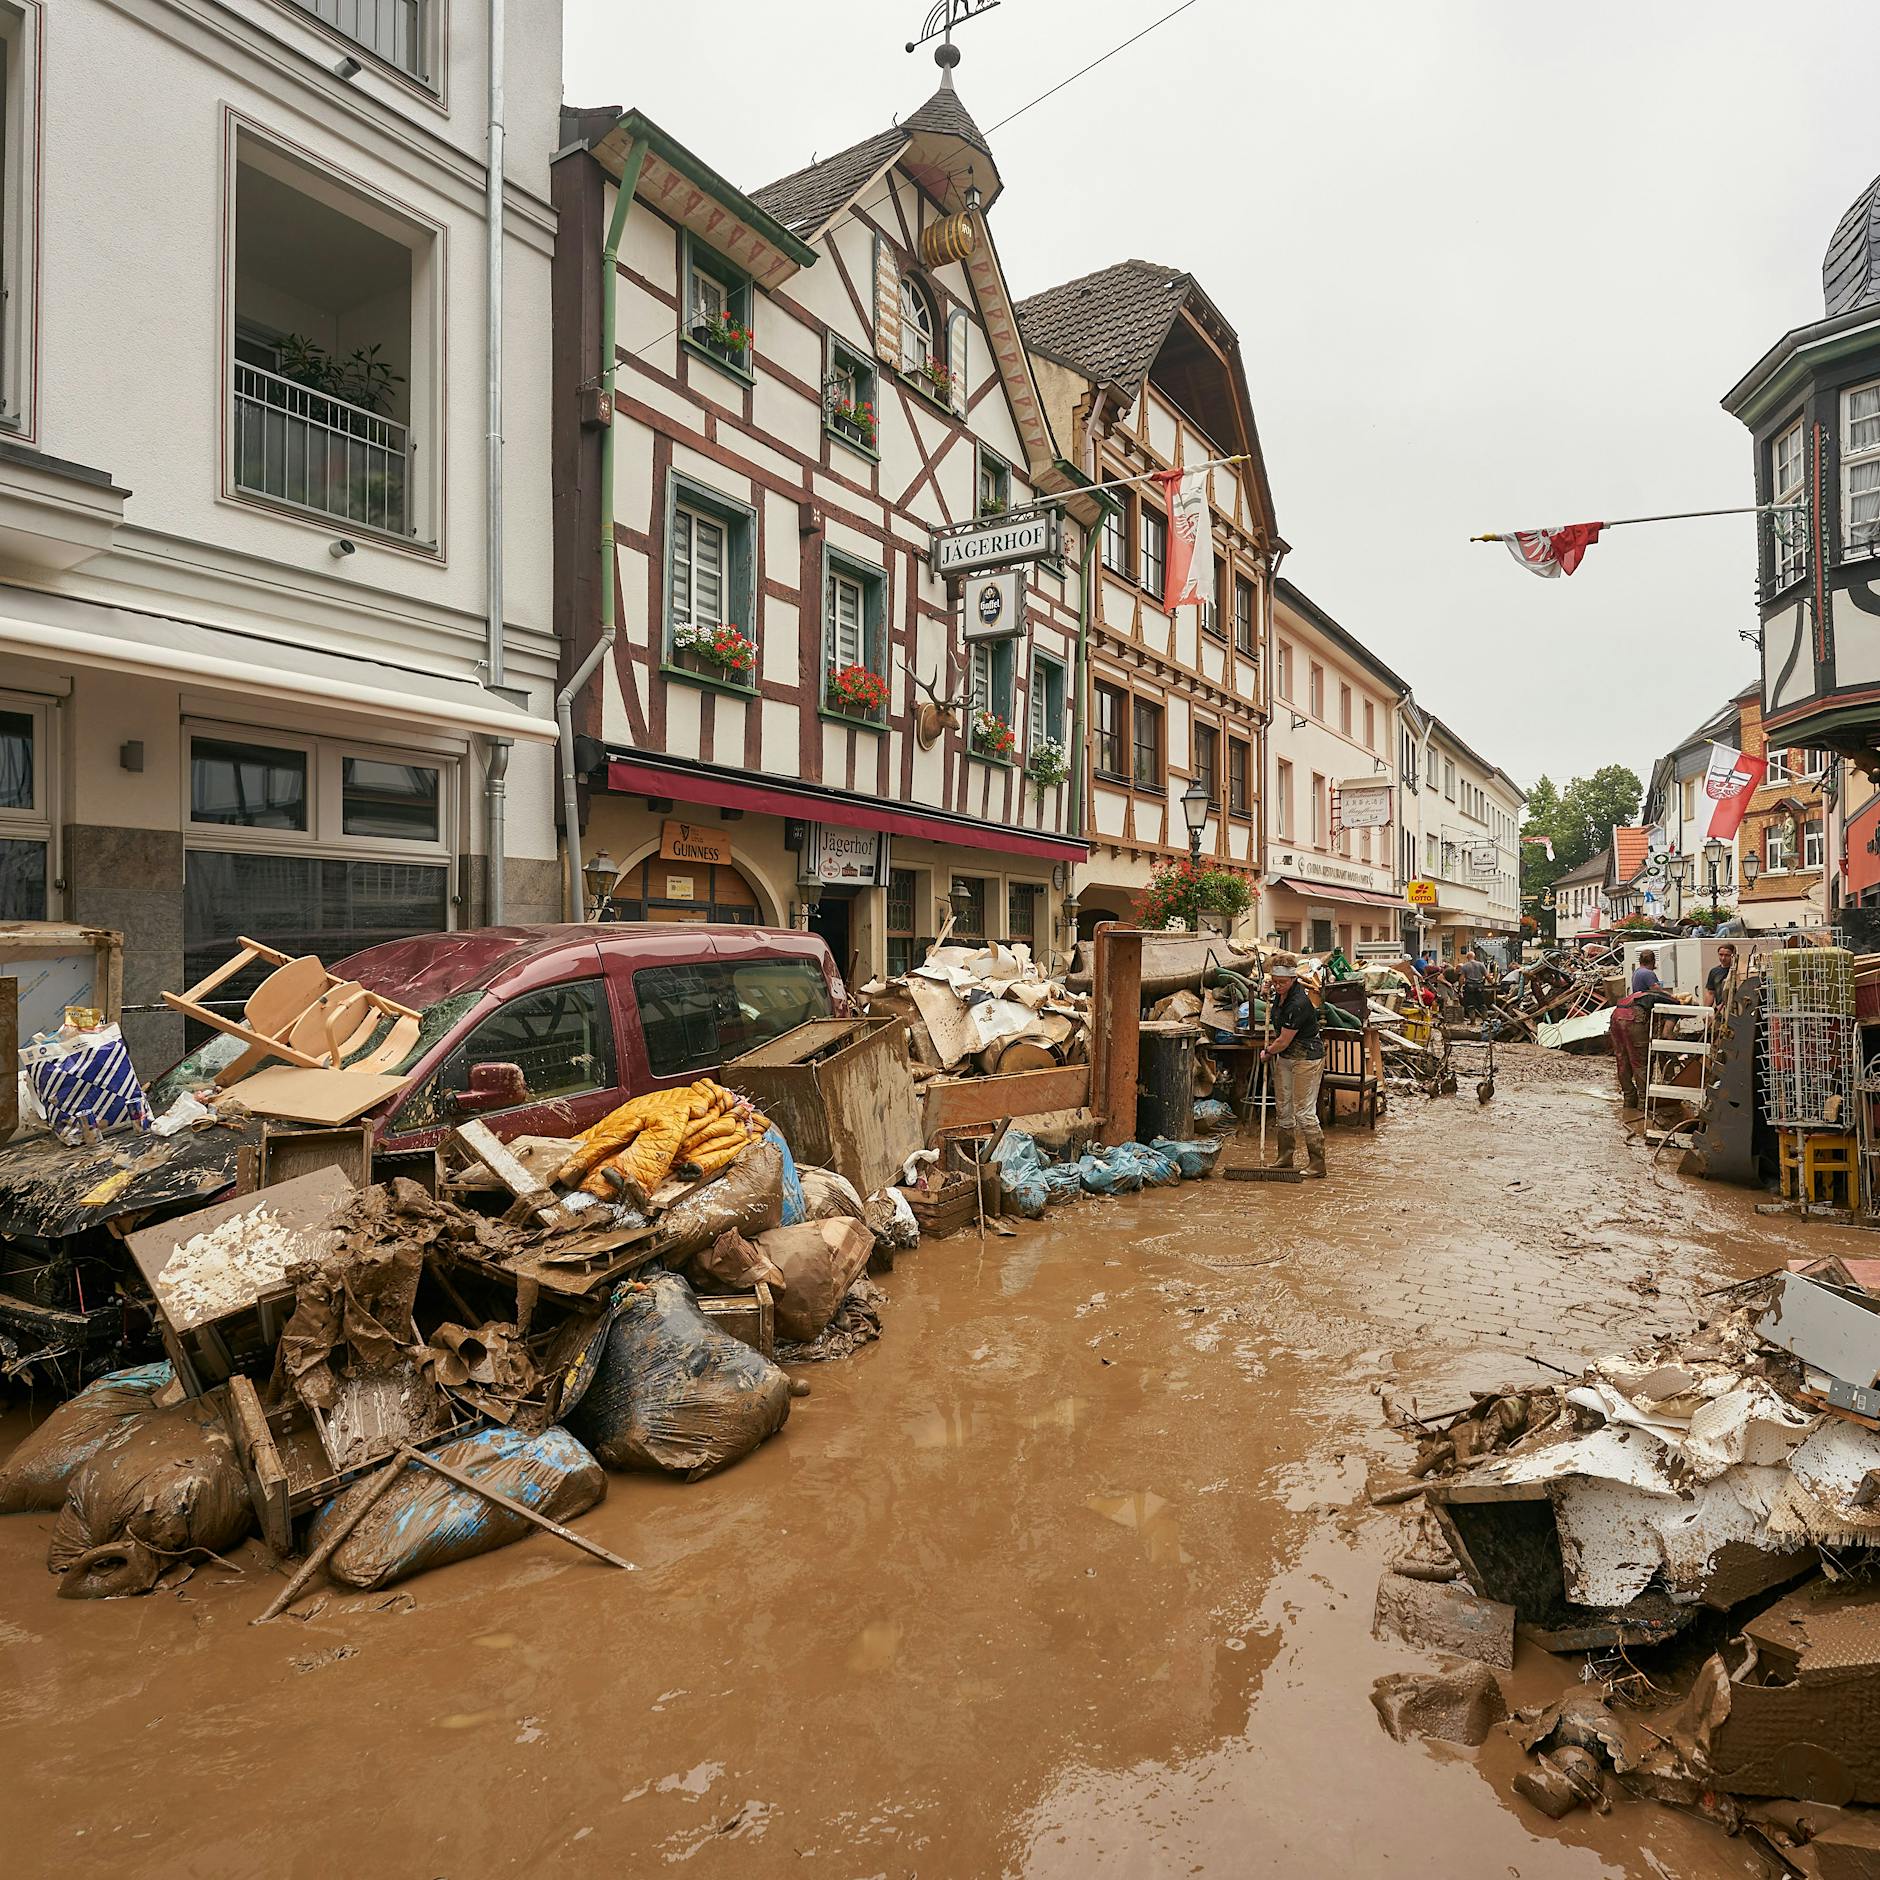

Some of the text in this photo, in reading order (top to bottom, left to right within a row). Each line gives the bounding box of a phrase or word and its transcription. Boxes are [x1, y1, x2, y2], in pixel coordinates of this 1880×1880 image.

[942, 526, 1044, 564] JÄGERHOF
[980, 598, 1001, 611] Gaffel
[673, 840, 720, 861] GUINNESS
[822, 832, 875, 857] Jägerhof
